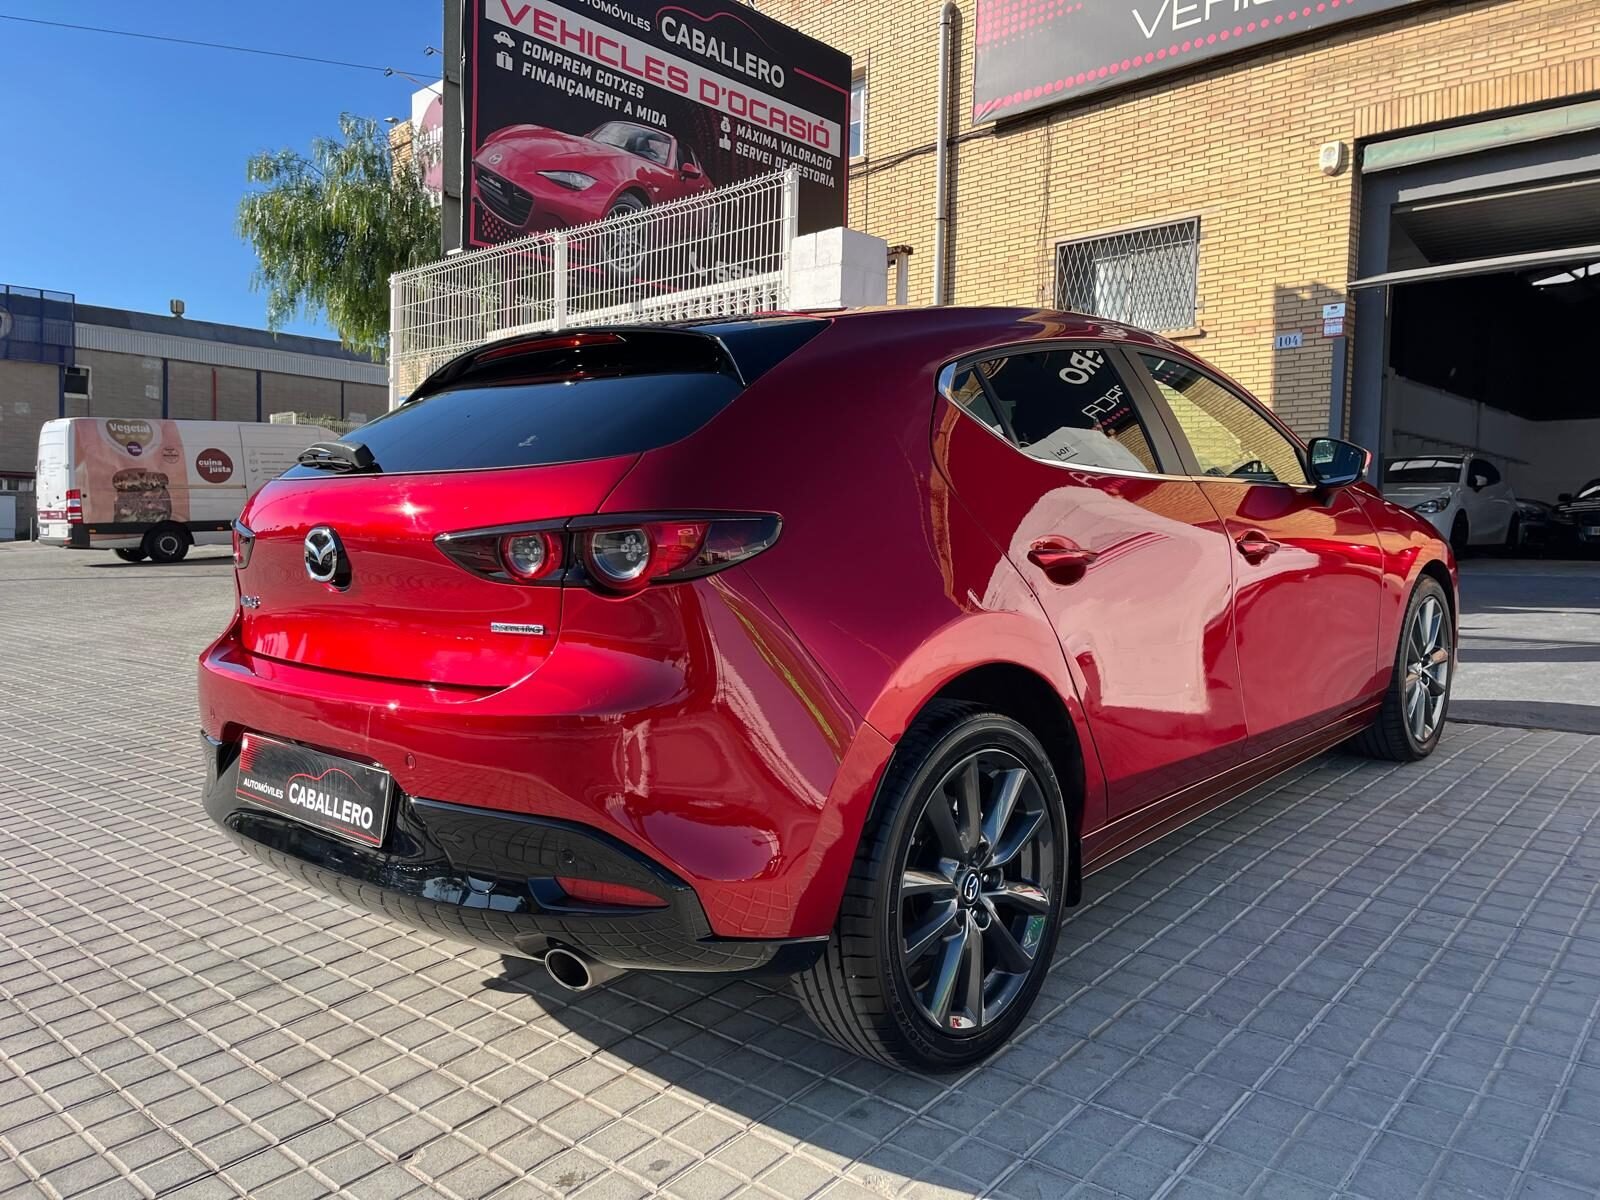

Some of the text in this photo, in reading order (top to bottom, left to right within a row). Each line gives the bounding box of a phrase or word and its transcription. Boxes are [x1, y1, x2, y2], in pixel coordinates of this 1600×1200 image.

[501, 0, 830, 149] VEHICLES D'OCASIÓ
[522, 40, 645, 99] COMPREM COTXES
[662, 16, 785, 89] CABALLERO
[522, 61, 667, 127] FINANÇAMENT A MIDA
[735, 141, 773, 166] SERVEI
[774, 156, 788, 171] DE
[736, 123, 833, 171] MÀXIMA VALORACIÓ
[1279, 335, 1298, 347] 104
[109, 422, 151, 434] Vegetal
[198, 457, 222, 466] cuina
[209, 465, 232, 474] justa
[243, 777, 373, 830] AUTOMÓVILES CABALLERO
